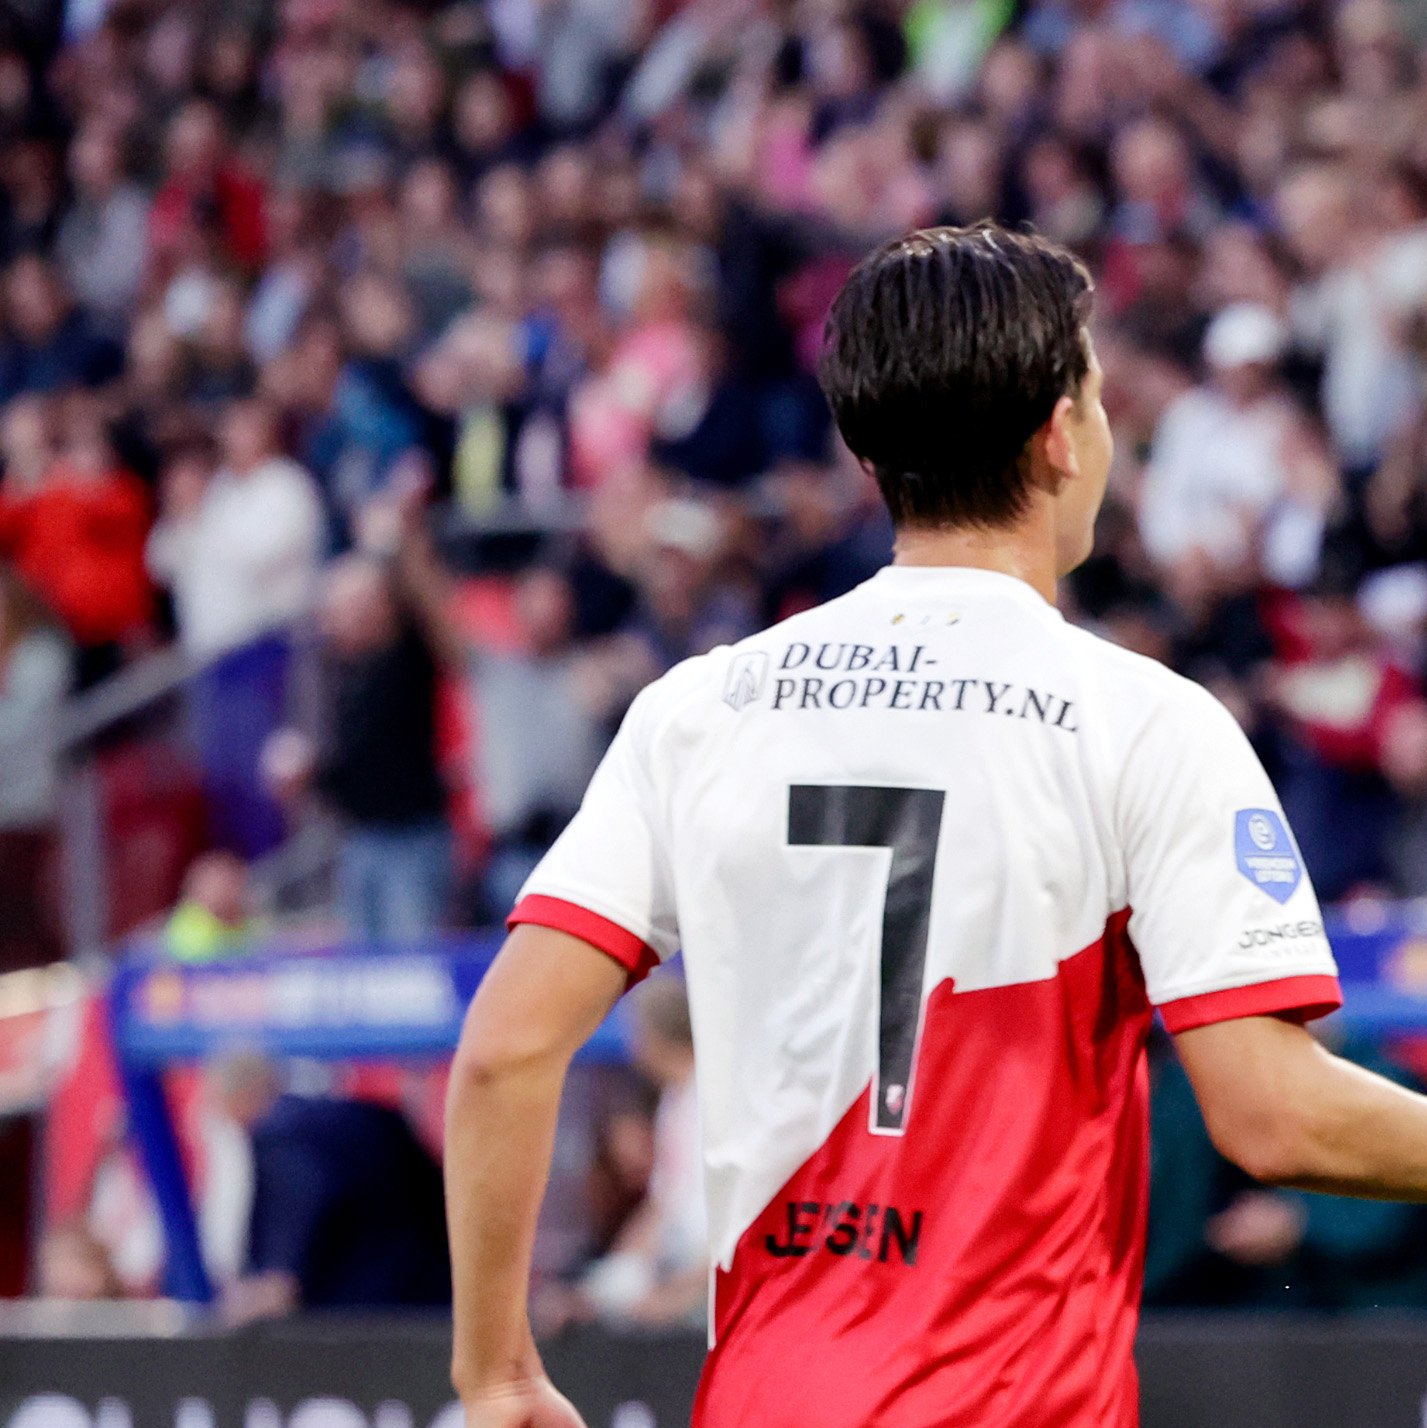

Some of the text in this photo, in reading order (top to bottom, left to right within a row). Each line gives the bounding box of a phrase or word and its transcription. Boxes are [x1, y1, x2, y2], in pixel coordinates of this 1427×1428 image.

[778, 642, 938, 672] DUBAI-
[771, 677, 1079, 732] PROPERTY.NL
[787, 783, 946, 1134] 7
